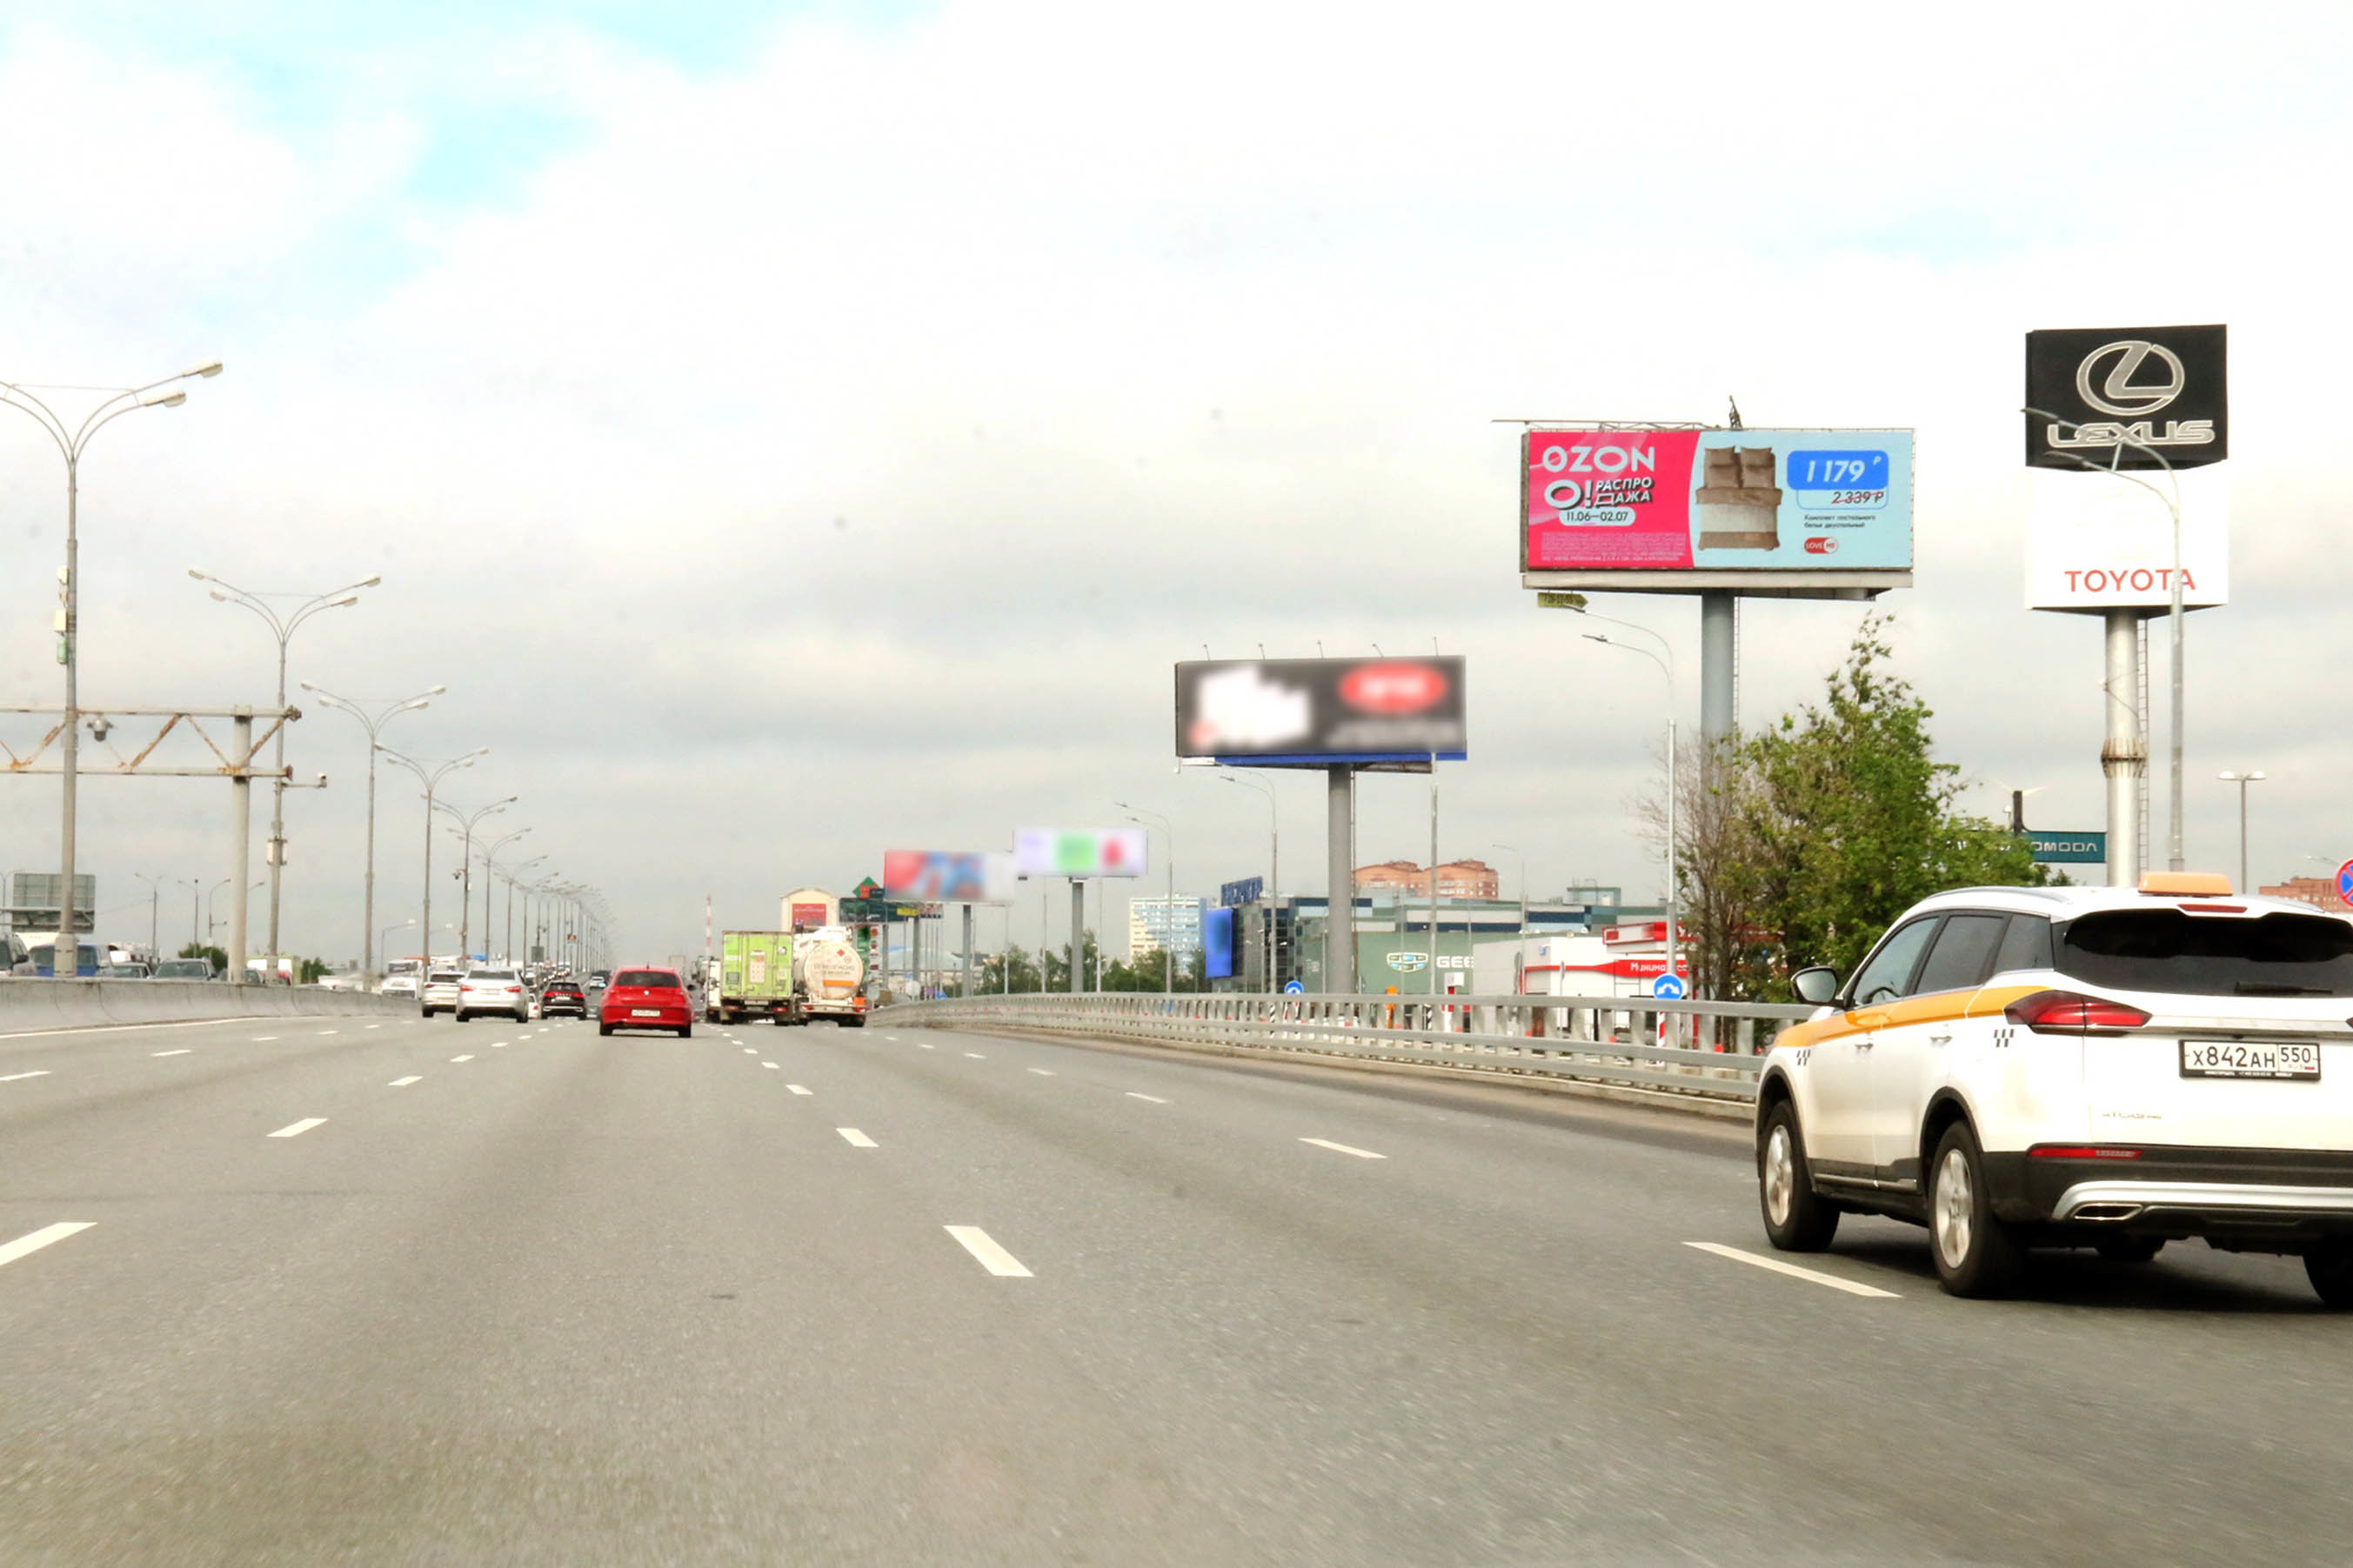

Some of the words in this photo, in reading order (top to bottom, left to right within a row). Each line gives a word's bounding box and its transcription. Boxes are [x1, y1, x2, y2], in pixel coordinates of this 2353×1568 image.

[2047, 420, 2216, 448] LEXUS
[1542, 445, 1655, 472] OZON
[1595, 477, 1654, 492] РАСПРО
[1594, 490, 1652, 507] ДАЖА
[2064, 569, 2196, 592] TOYOTA
[2281, 1046, 2311, 1064] 550
